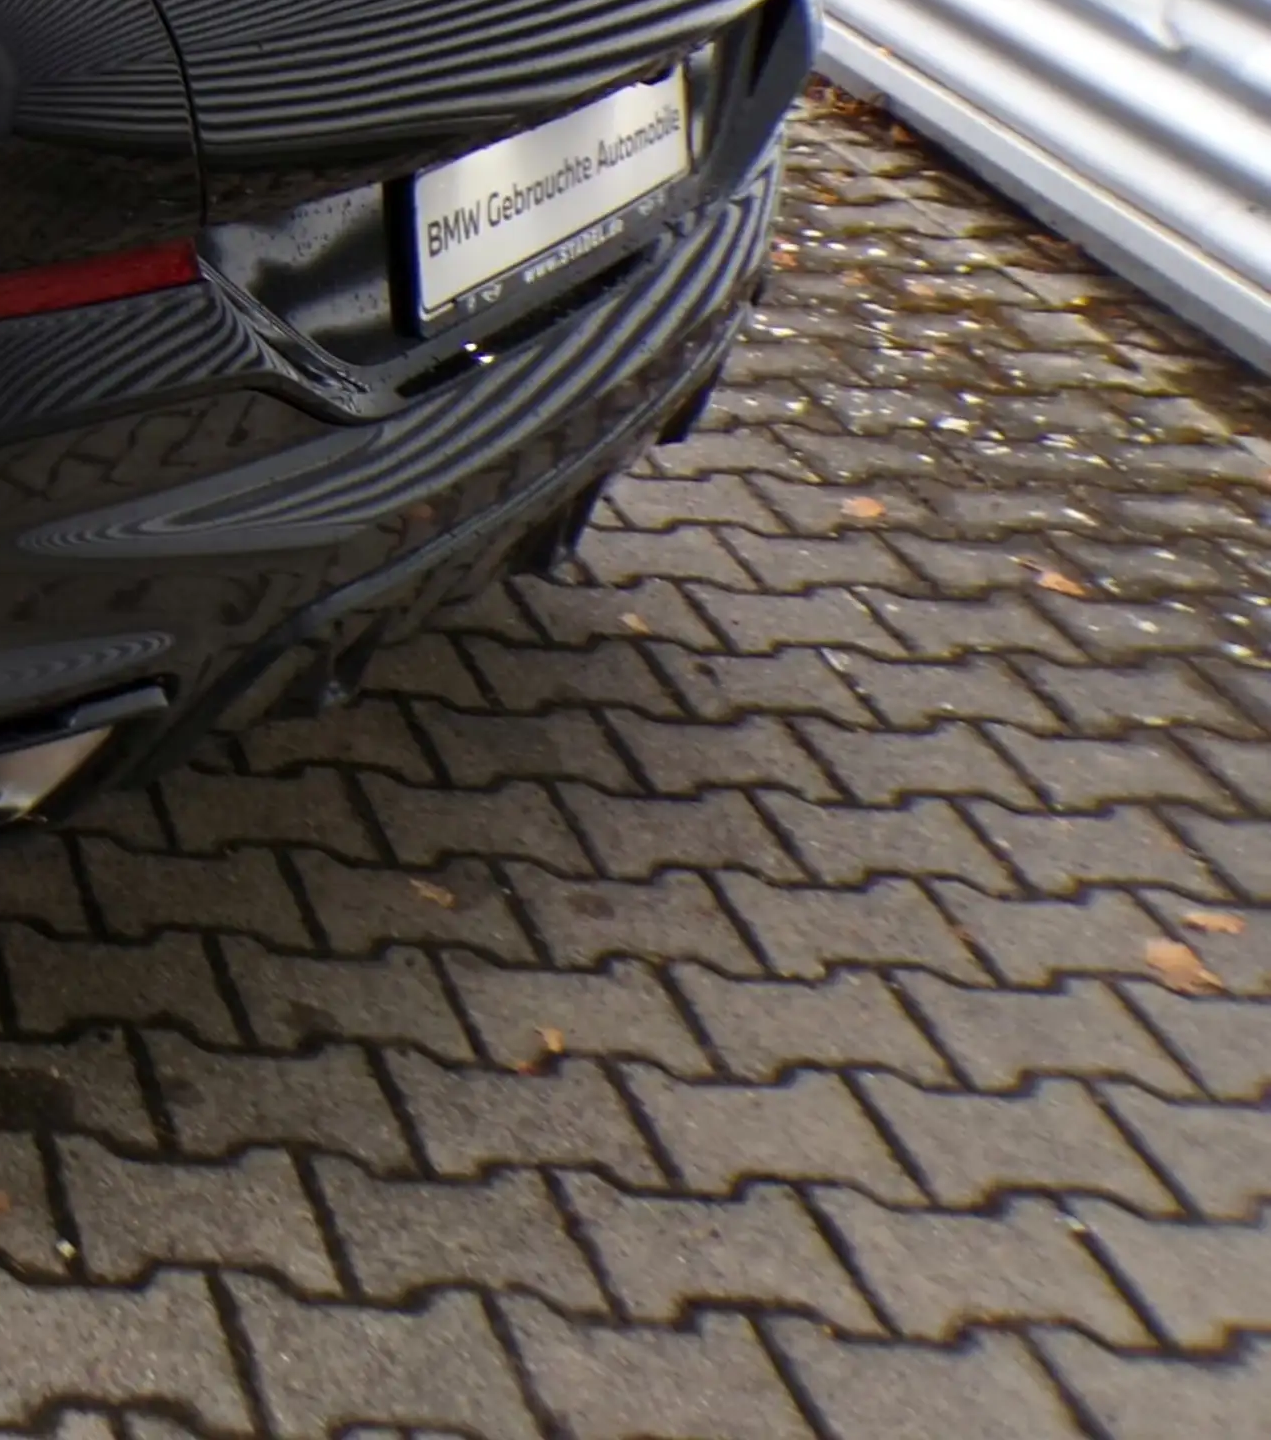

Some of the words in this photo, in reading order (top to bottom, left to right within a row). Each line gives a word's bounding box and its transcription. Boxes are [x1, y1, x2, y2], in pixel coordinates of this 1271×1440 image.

[426, 200, 482, 257] BMW
[487, 154, 592, 227] Gebrauchte
[596, 104, 681, 170] Automobile
